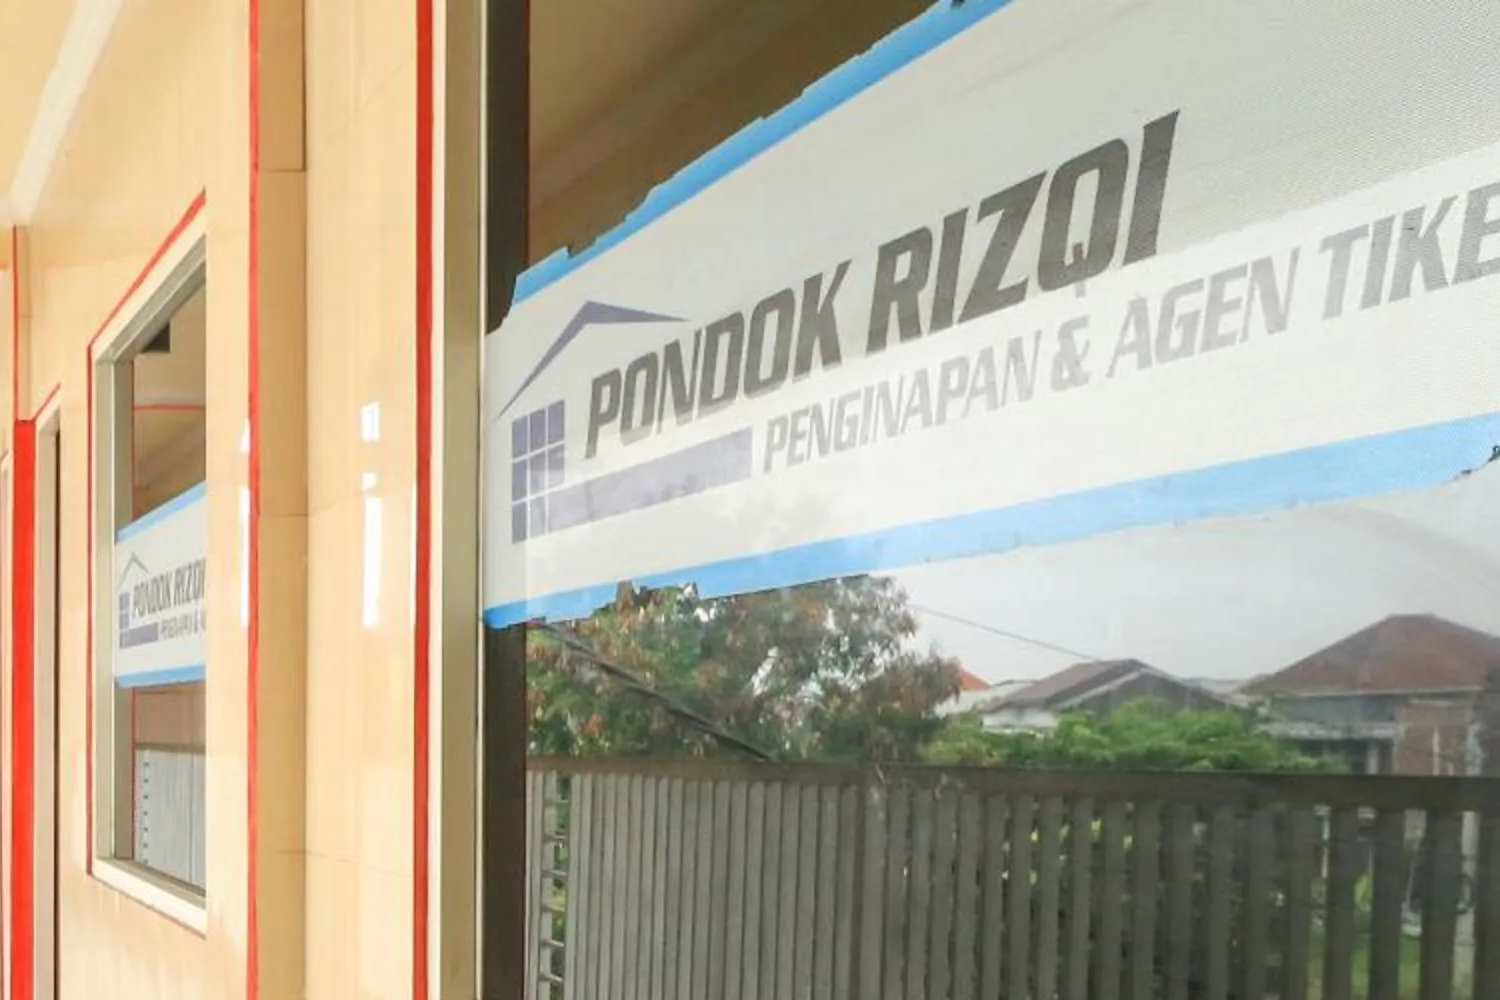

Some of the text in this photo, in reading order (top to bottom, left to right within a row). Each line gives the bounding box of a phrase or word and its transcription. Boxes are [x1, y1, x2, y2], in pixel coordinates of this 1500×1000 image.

[585, 109, 1180, 460] PONDOK RIZQI
[762, 328, 1042, 474] PENGINAPAN
[1049, 313, 1091, 393] &
[1105, 246, 1301, 377] AGEN
